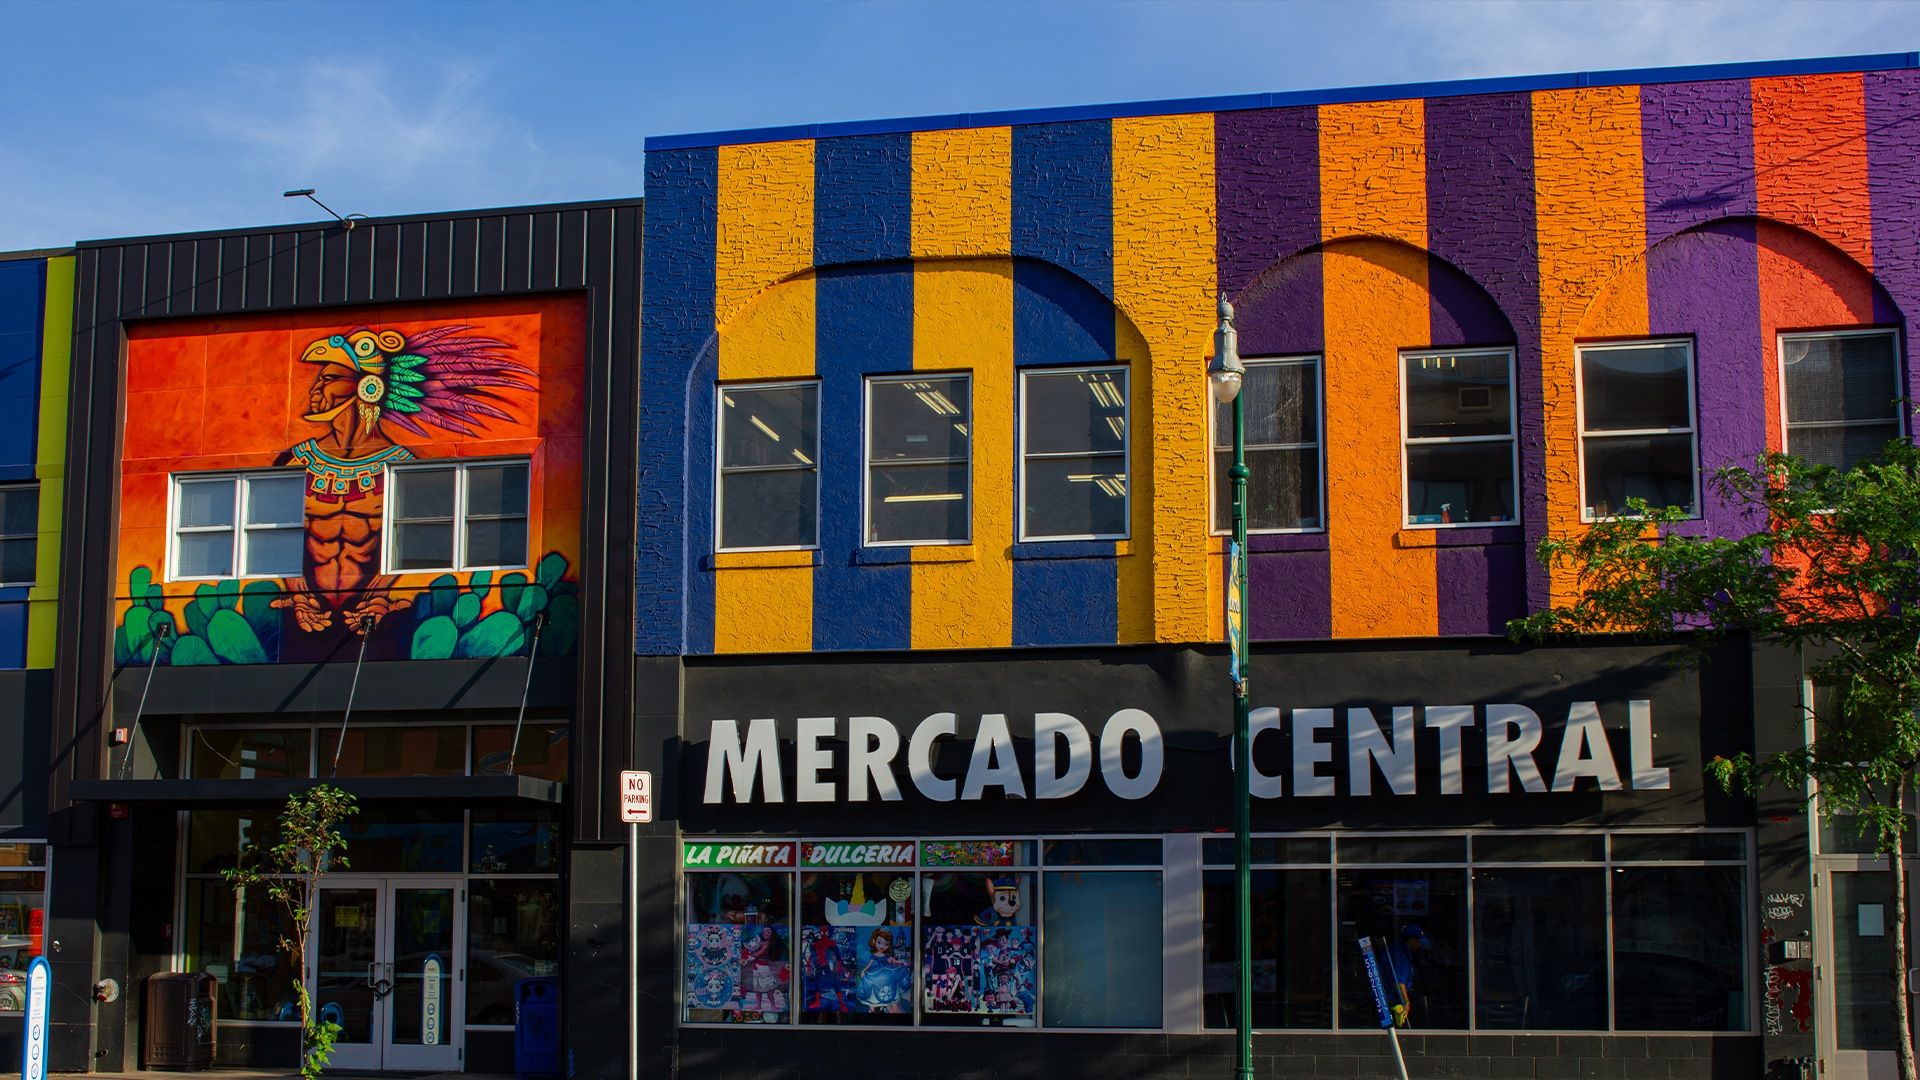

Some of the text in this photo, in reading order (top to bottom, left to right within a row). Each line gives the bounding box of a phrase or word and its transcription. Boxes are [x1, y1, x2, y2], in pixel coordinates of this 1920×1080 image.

[703, 700, 1670, 804] MERCADO CENTRAL
[629, 778, 644, 791] NO
[624, 794, 649, 804] PARKING
[686, 844, 914, 865] LA PIÑATA DULCERIA
